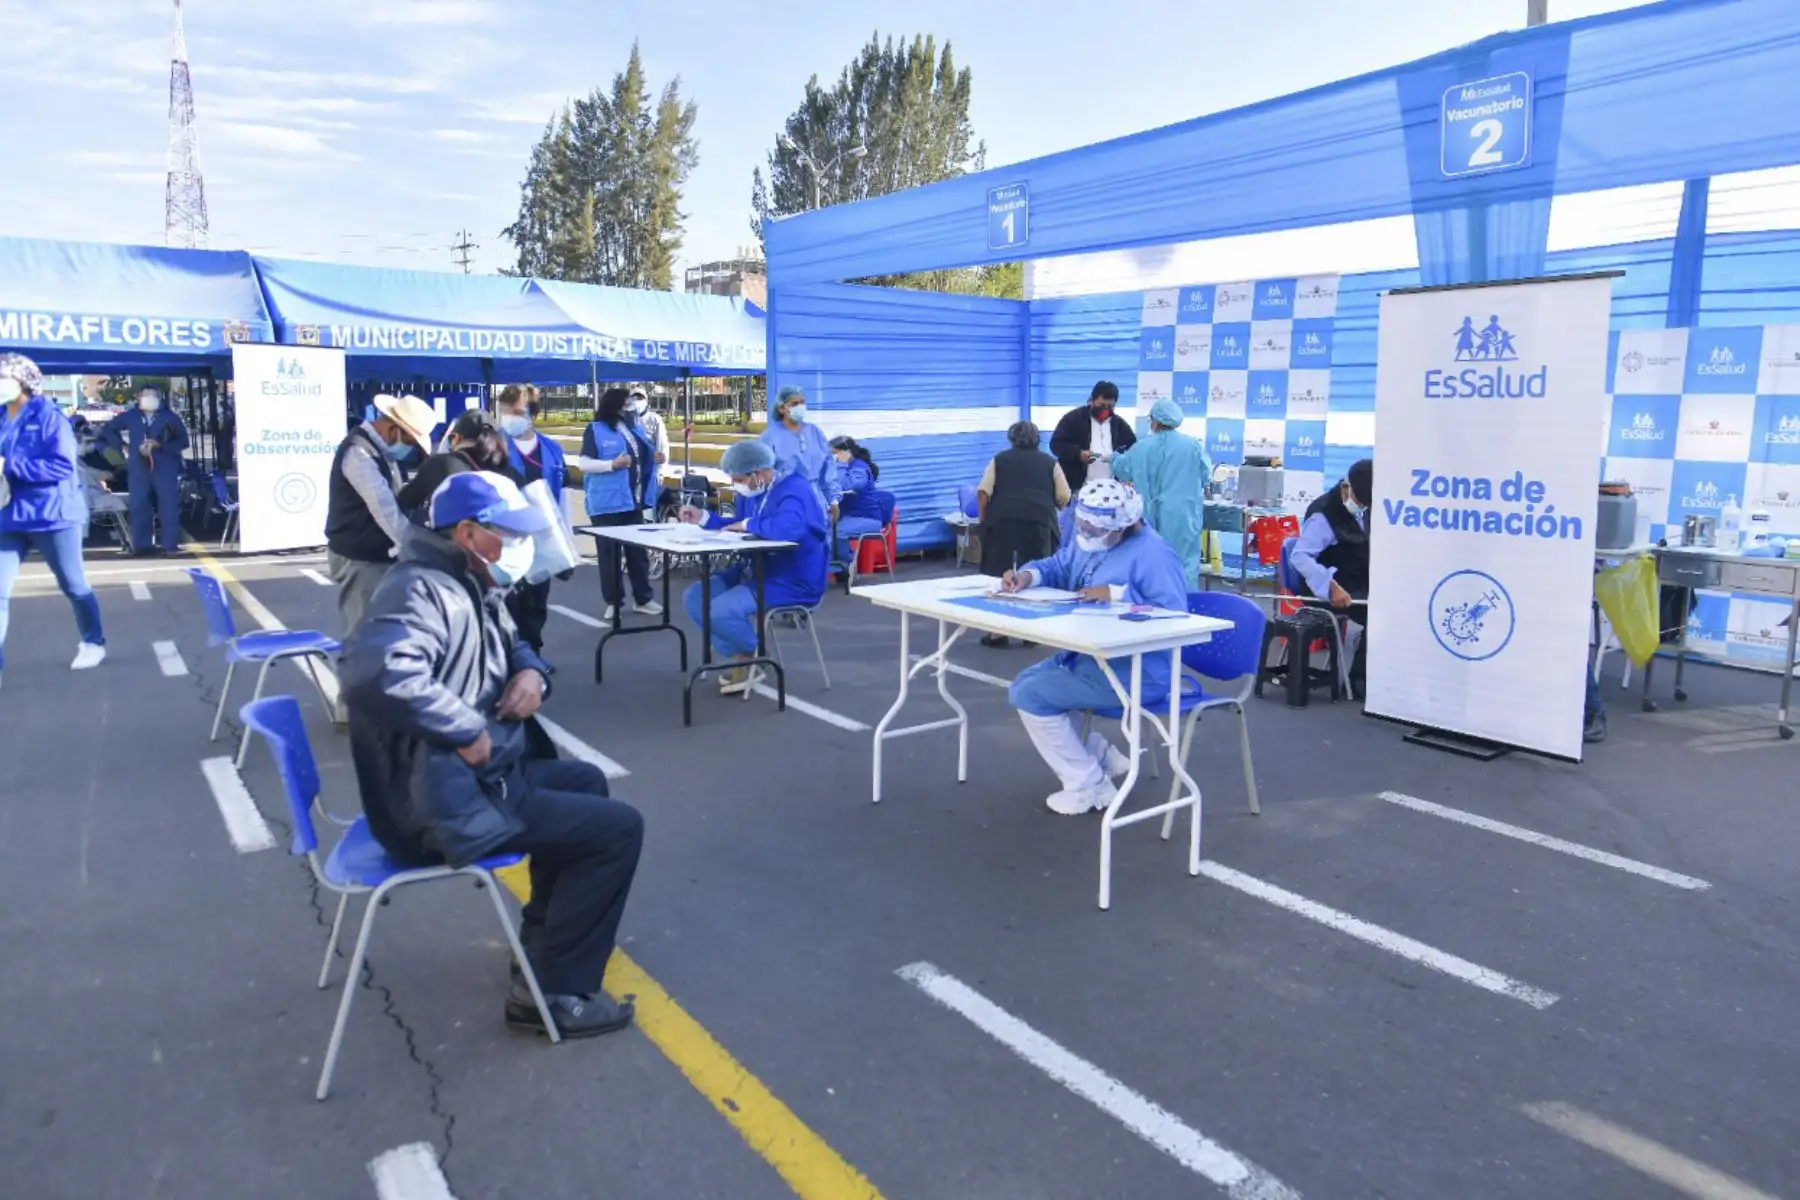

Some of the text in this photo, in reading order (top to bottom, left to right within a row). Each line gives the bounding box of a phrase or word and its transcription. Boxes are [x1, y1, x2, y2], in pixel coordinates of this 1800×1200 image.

[1447, 96, 1524, 122] Vacunatorio
[1468, 118, 1503, 167] 2
[1002, 211, 1013, 243] 1
[0, 311, 212, 348] MIRAFLORES
[330, 324, 526, 352] MUNICIPALIDAD
[643, 341, 670, 362] DE
[1424, 365, 1547, 399] EsSalud
[1697, 363, 1746, 375] EsSalud
[260, 381, 322, 397] EsSalud
[262, 429, 322, 442] Zona de
[1620, 428, 1665, 441] EsSalud
[1410, 469, 1546, 504] Zona de
[1383, 498, 1583, 540] Vacunación
